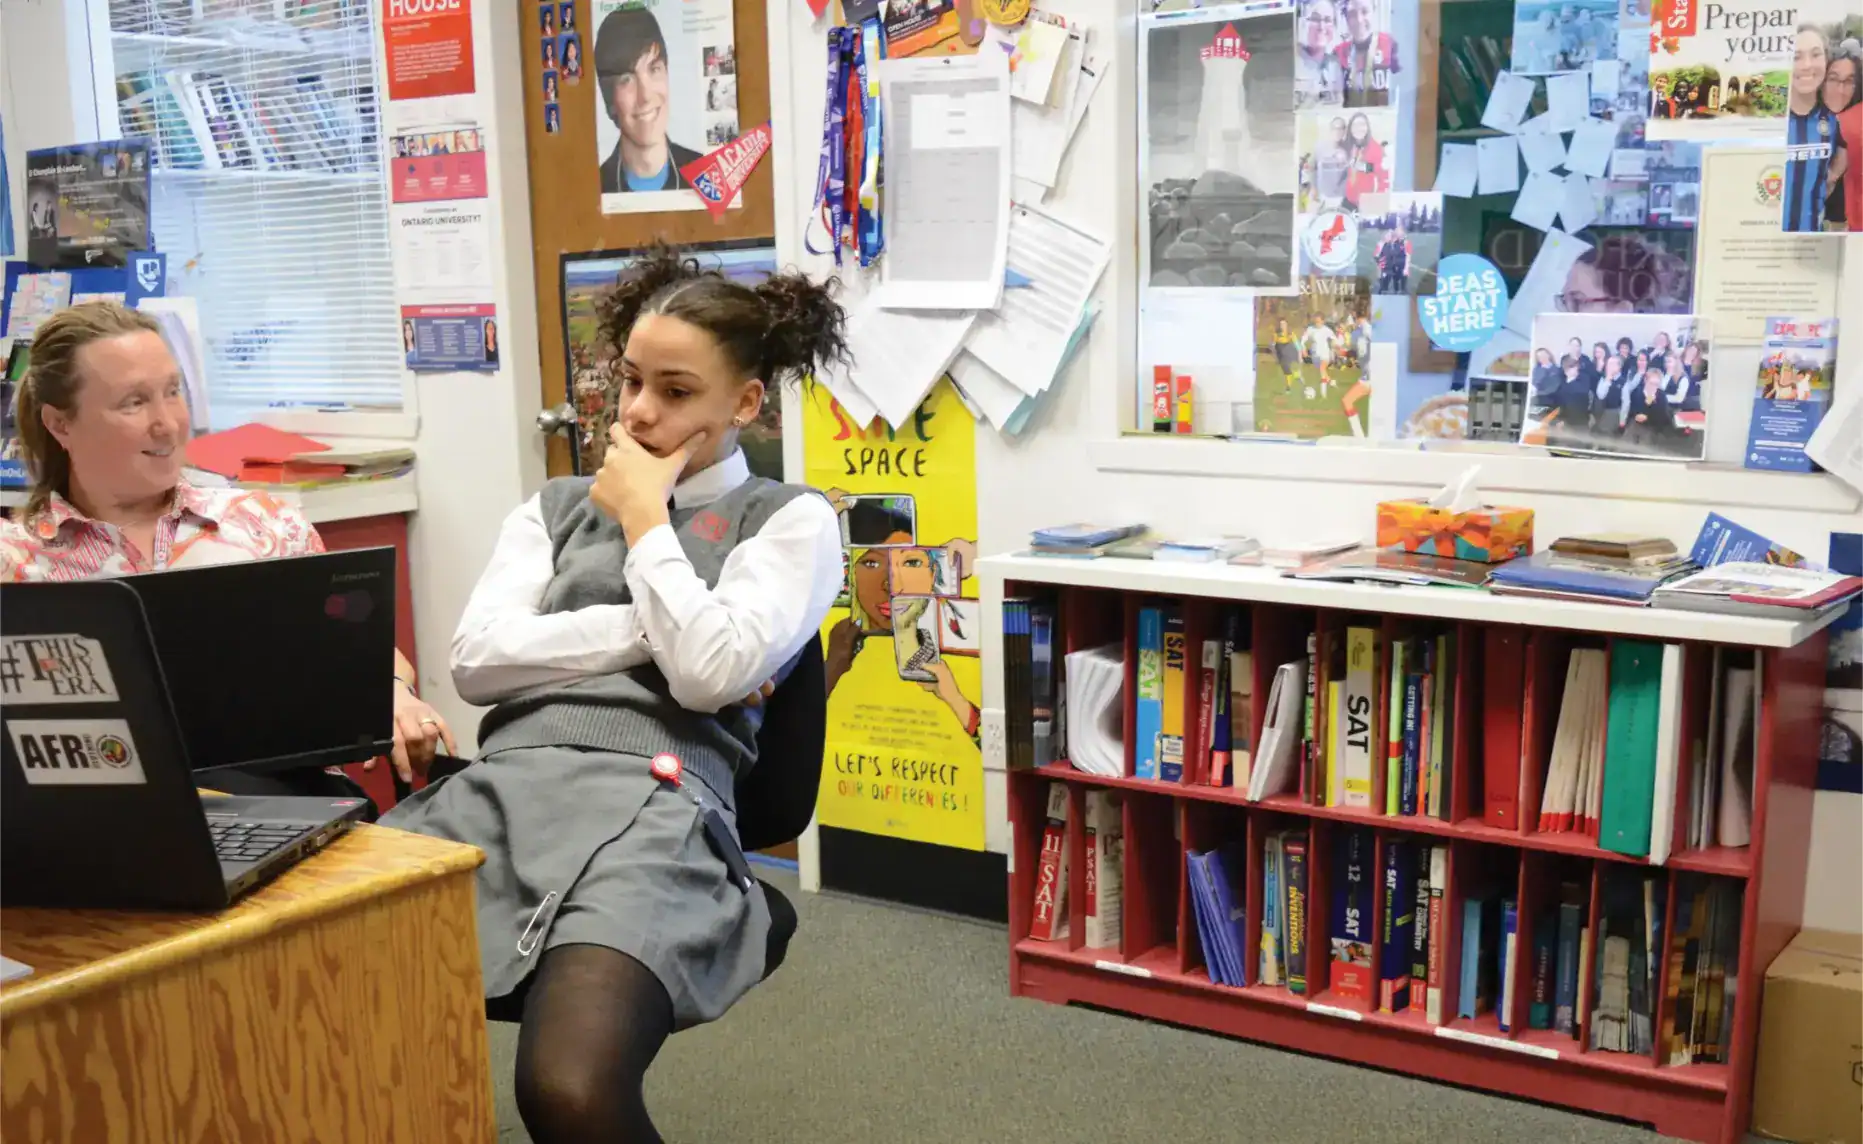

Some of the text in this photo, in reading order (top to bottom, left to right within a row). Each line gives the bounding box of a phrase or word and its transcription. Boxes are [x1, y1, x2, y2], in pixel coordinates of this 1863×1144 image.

[390, 0, 460, 17] HOUSE
[1704, 3, 1797, 35] Prepar
[716, 129, 766, 178] ACADIA
[1424, 288, 1501, 316] START
[1433, 309, 1495, 334] HERE
[830, 394, 936, 442] SE
[844, 448, 926, 477] SPACE
[1166, 636, 1185, 672] SAT
[1347, 695, 1370, 753] SAT
[835, 752, 959, 785] LET'S RESPECT
[1086, 847, 1095, 892] PSAT
[1385, 868, 1397, 890] SAT
[1036, 863, 1055, 920] SAT
[1416, 878, 1429, 905] SAT
[1345, 907, 1360, 938] SAT
